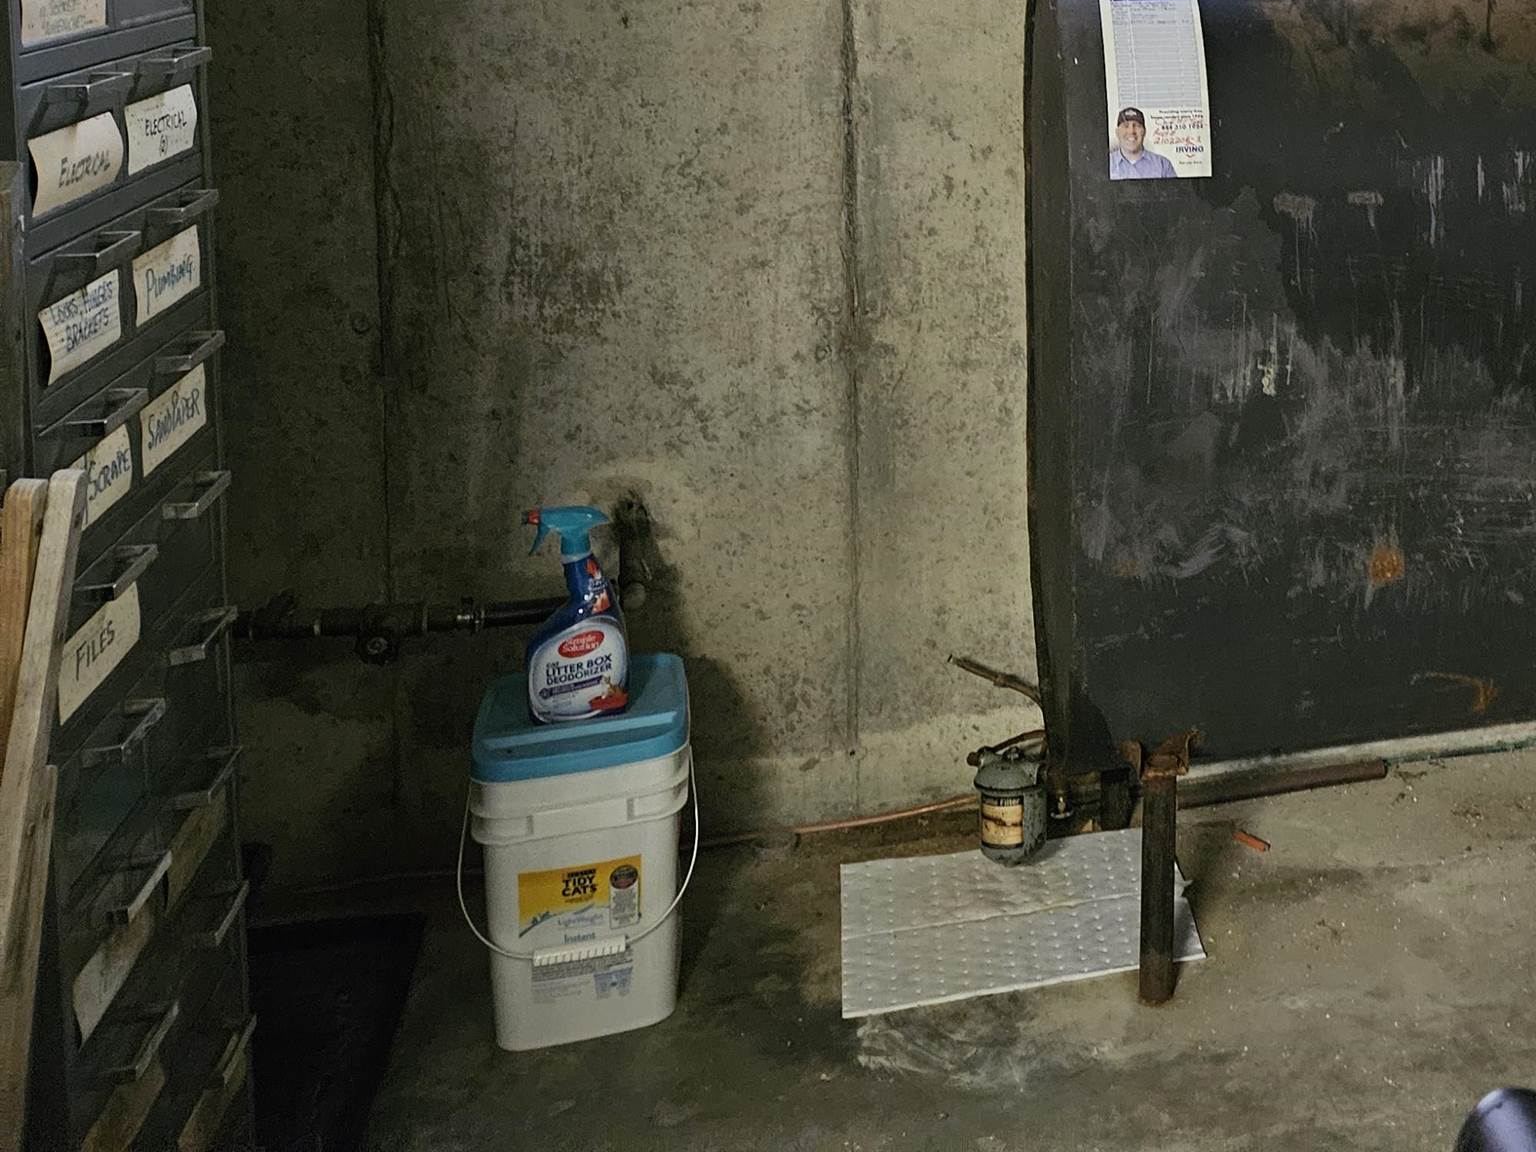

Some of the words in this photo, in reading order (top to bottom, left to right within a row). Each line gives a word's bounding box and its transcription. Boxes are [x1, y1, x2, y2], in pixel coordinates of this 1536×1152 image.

[145, 110, 188, 136] ELECTRICAL
[76, 620, 116, 682] FILES
[546, 662, 583, 678] LITTER
[587, 653, 612, 668] BOX
[546, 663, 612, 686] DEODORIZER
[562, 875, 595, 888] TIDY
[562, 884, 597, 897] CATS
